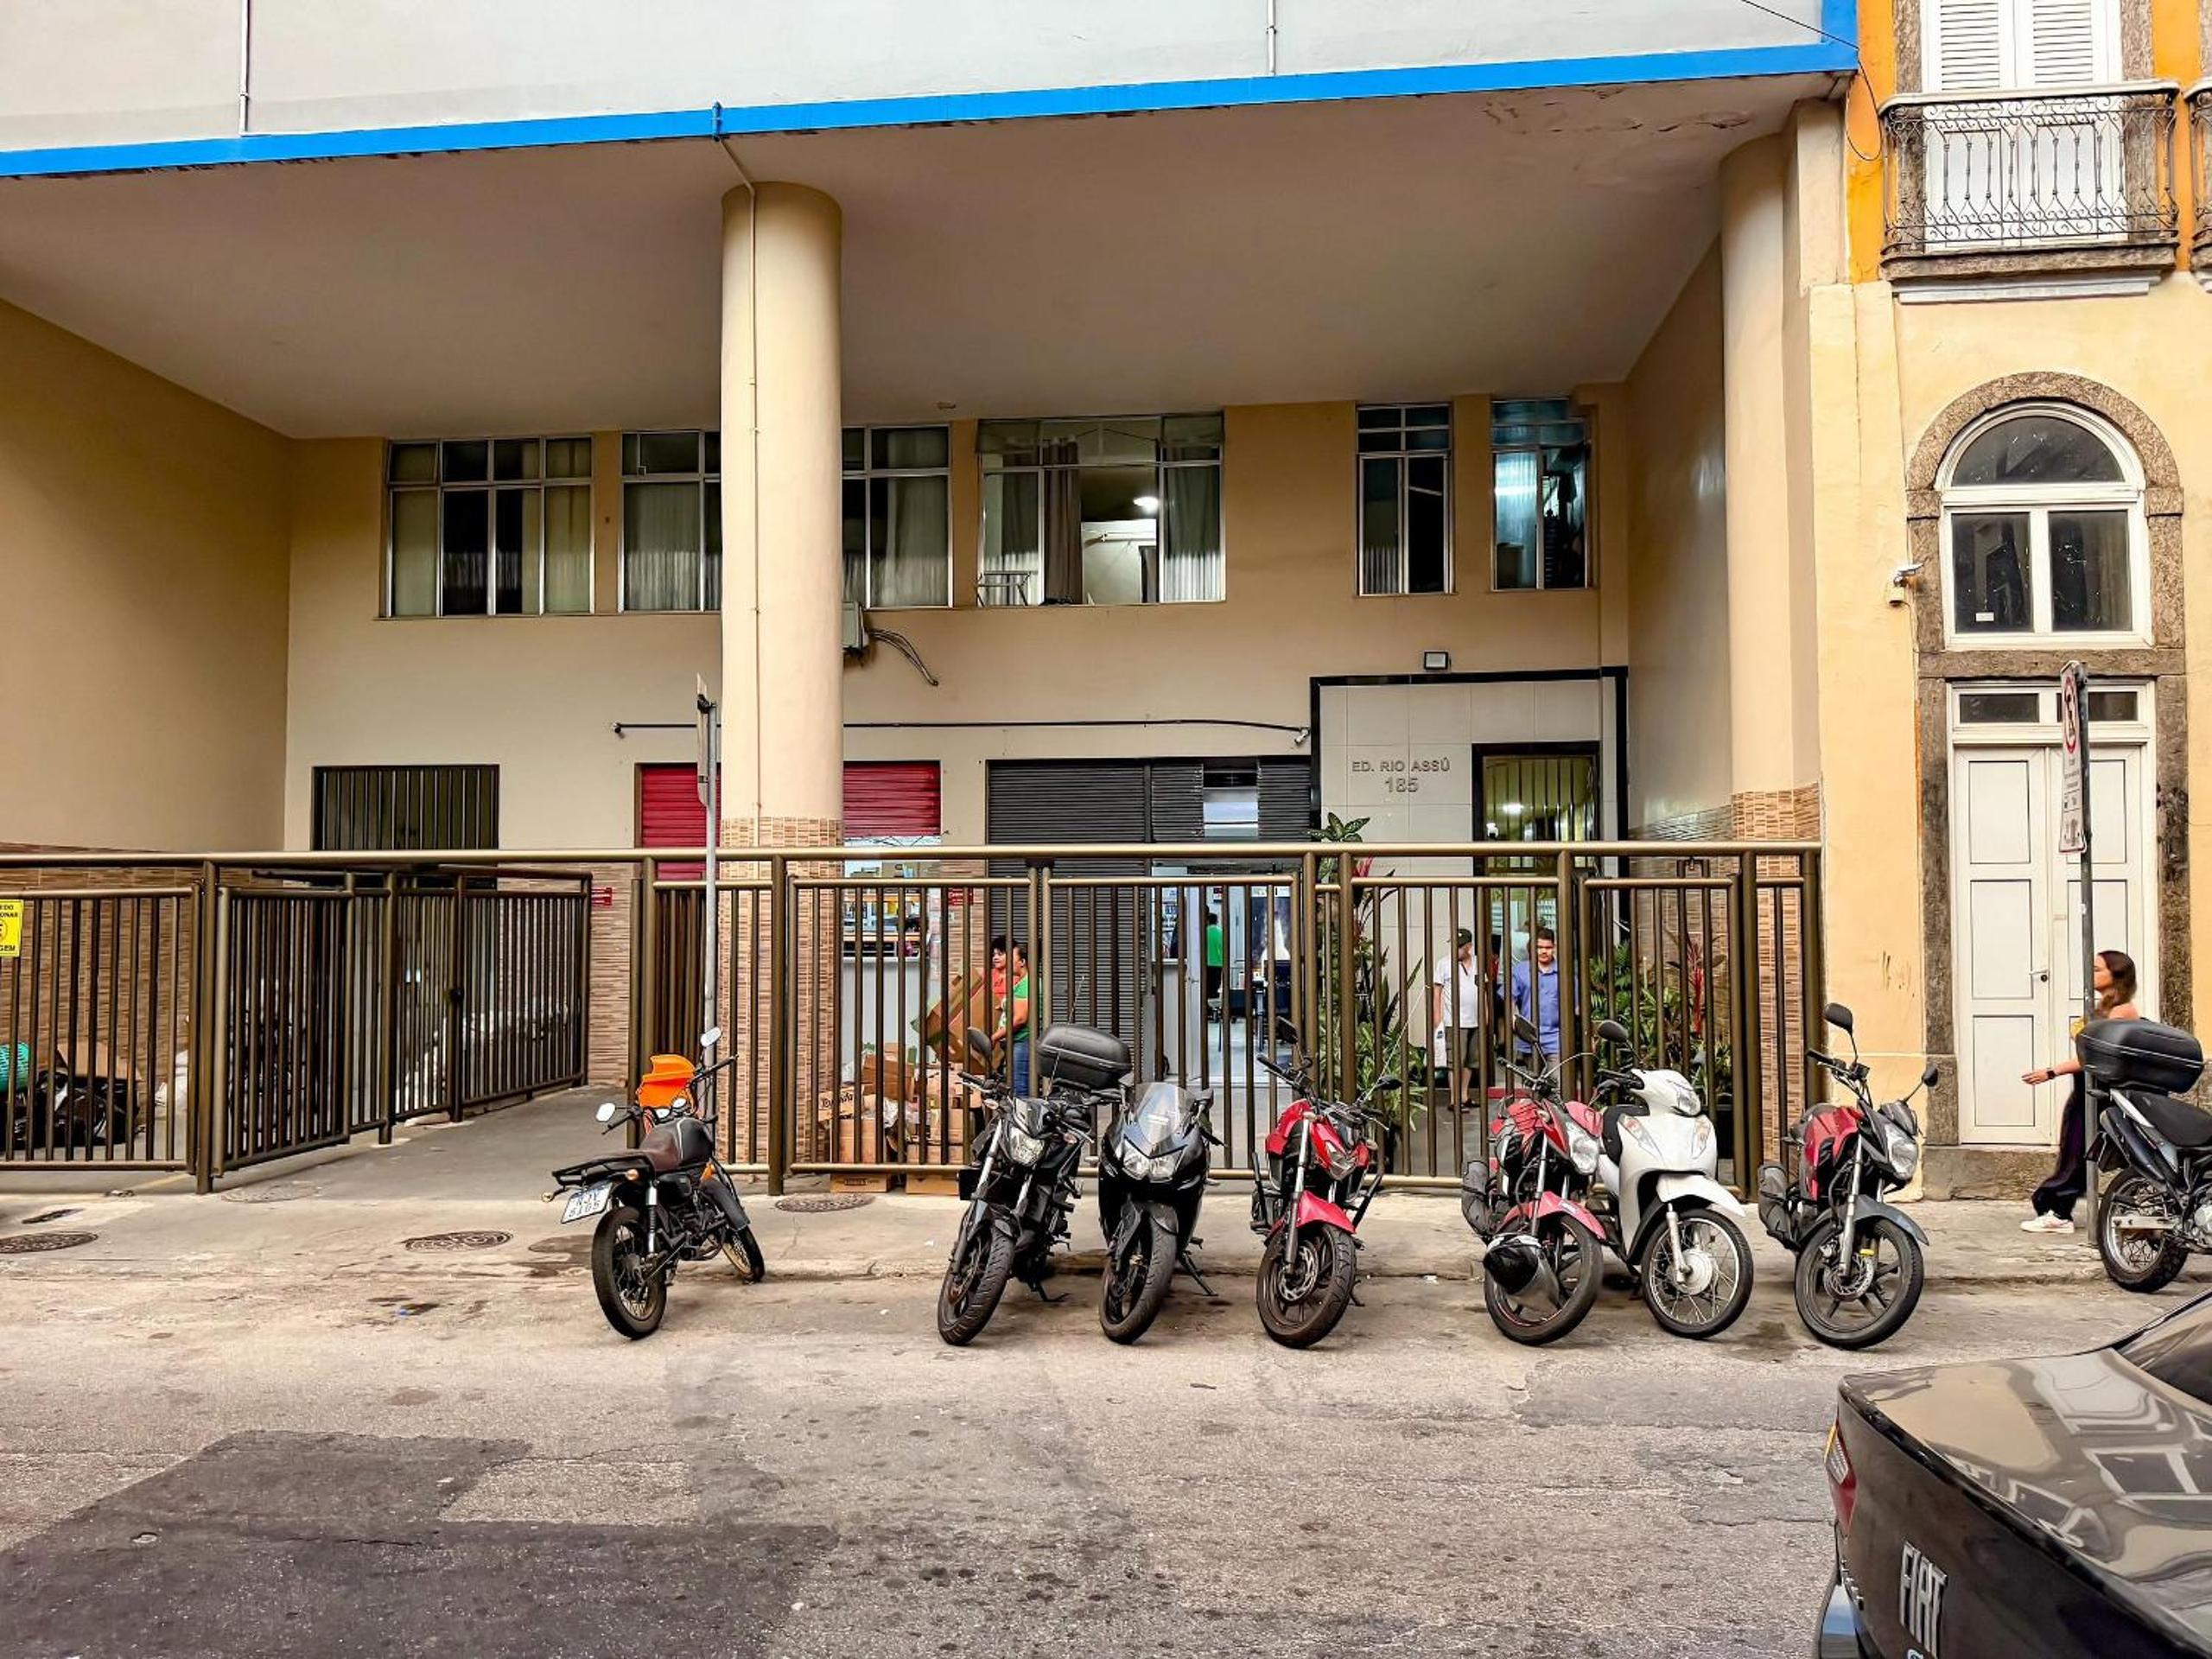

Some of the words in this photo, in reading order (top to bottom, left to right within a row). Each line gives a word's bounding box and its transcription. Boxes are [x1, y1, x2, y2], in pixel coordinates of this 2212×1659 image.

[1351, 760, 1375, 772] ED.
[1380, 760, 1405, 772] RIO
[1385, 777, 1418, 793] 185
[1900, 1540, 1948, 1659] FIAT
